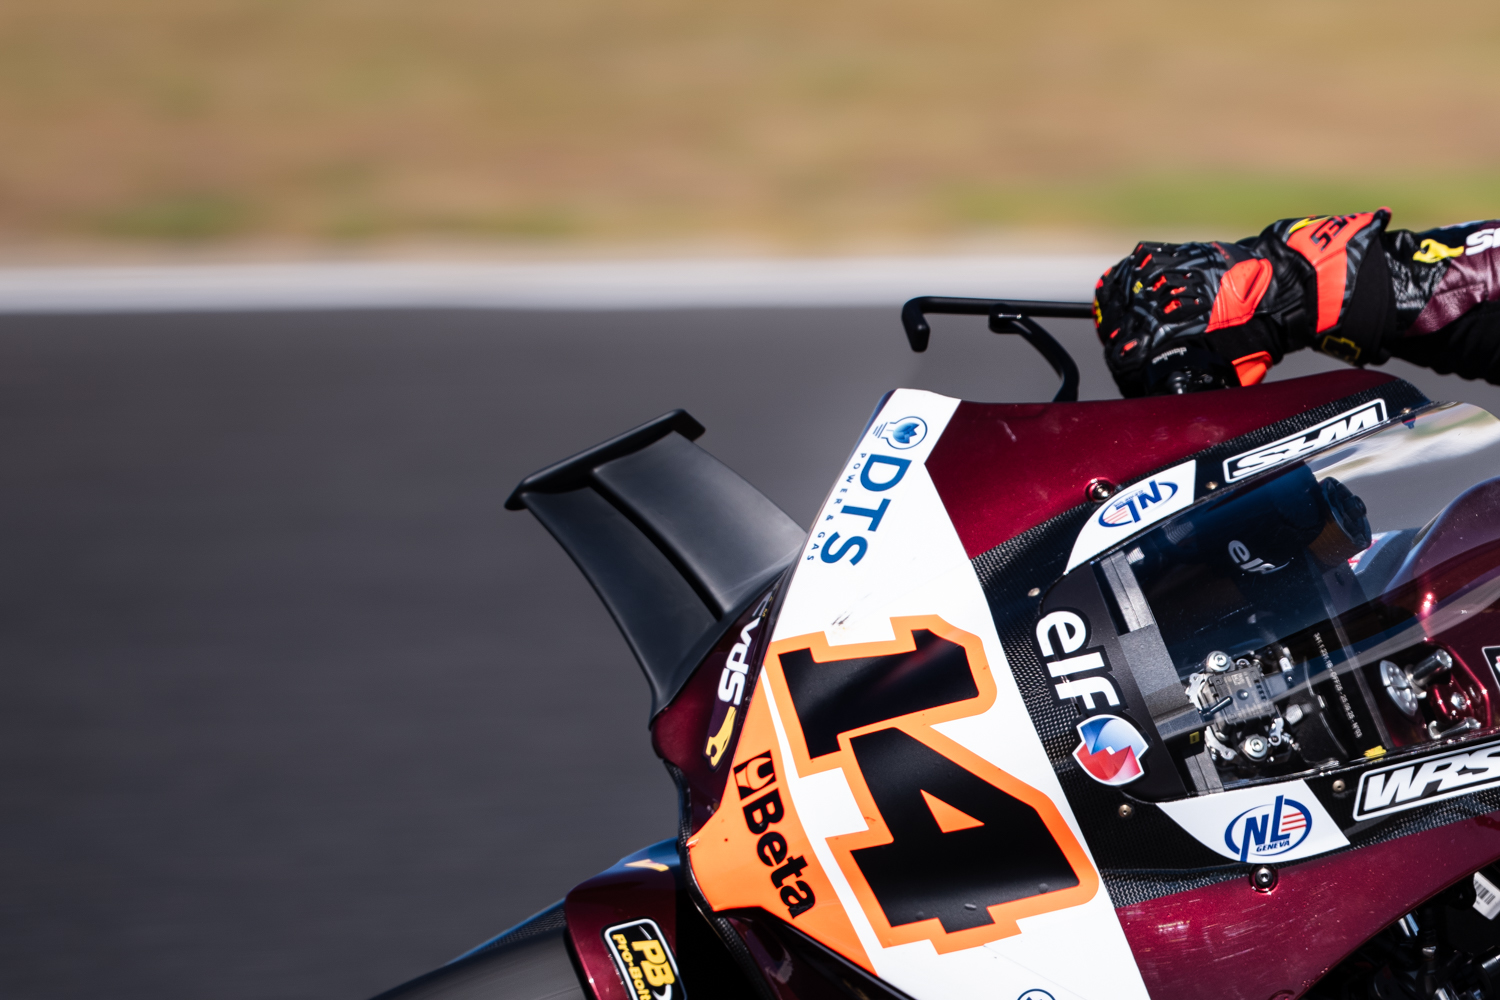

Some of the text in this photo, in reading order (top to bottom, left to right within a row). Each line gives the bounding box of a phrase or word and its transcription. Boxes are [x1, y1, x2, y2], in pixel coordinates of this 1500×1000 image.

[833, 452, 867, 505] POWER
[1115, 479, 1163, 524] NL
[820, 453, 912, 566] DTS
[806, 531, 826, 561] GAS
[1036, 611, 1123, 712] elf
[772, 622, 1090, 942] 14
[741, 787, 816, 920] Beta
[1239, 795, 1293, 863] NL
[1256, 839, 1291, 853] GENEVA
[631, 939, 676, 987] PB
